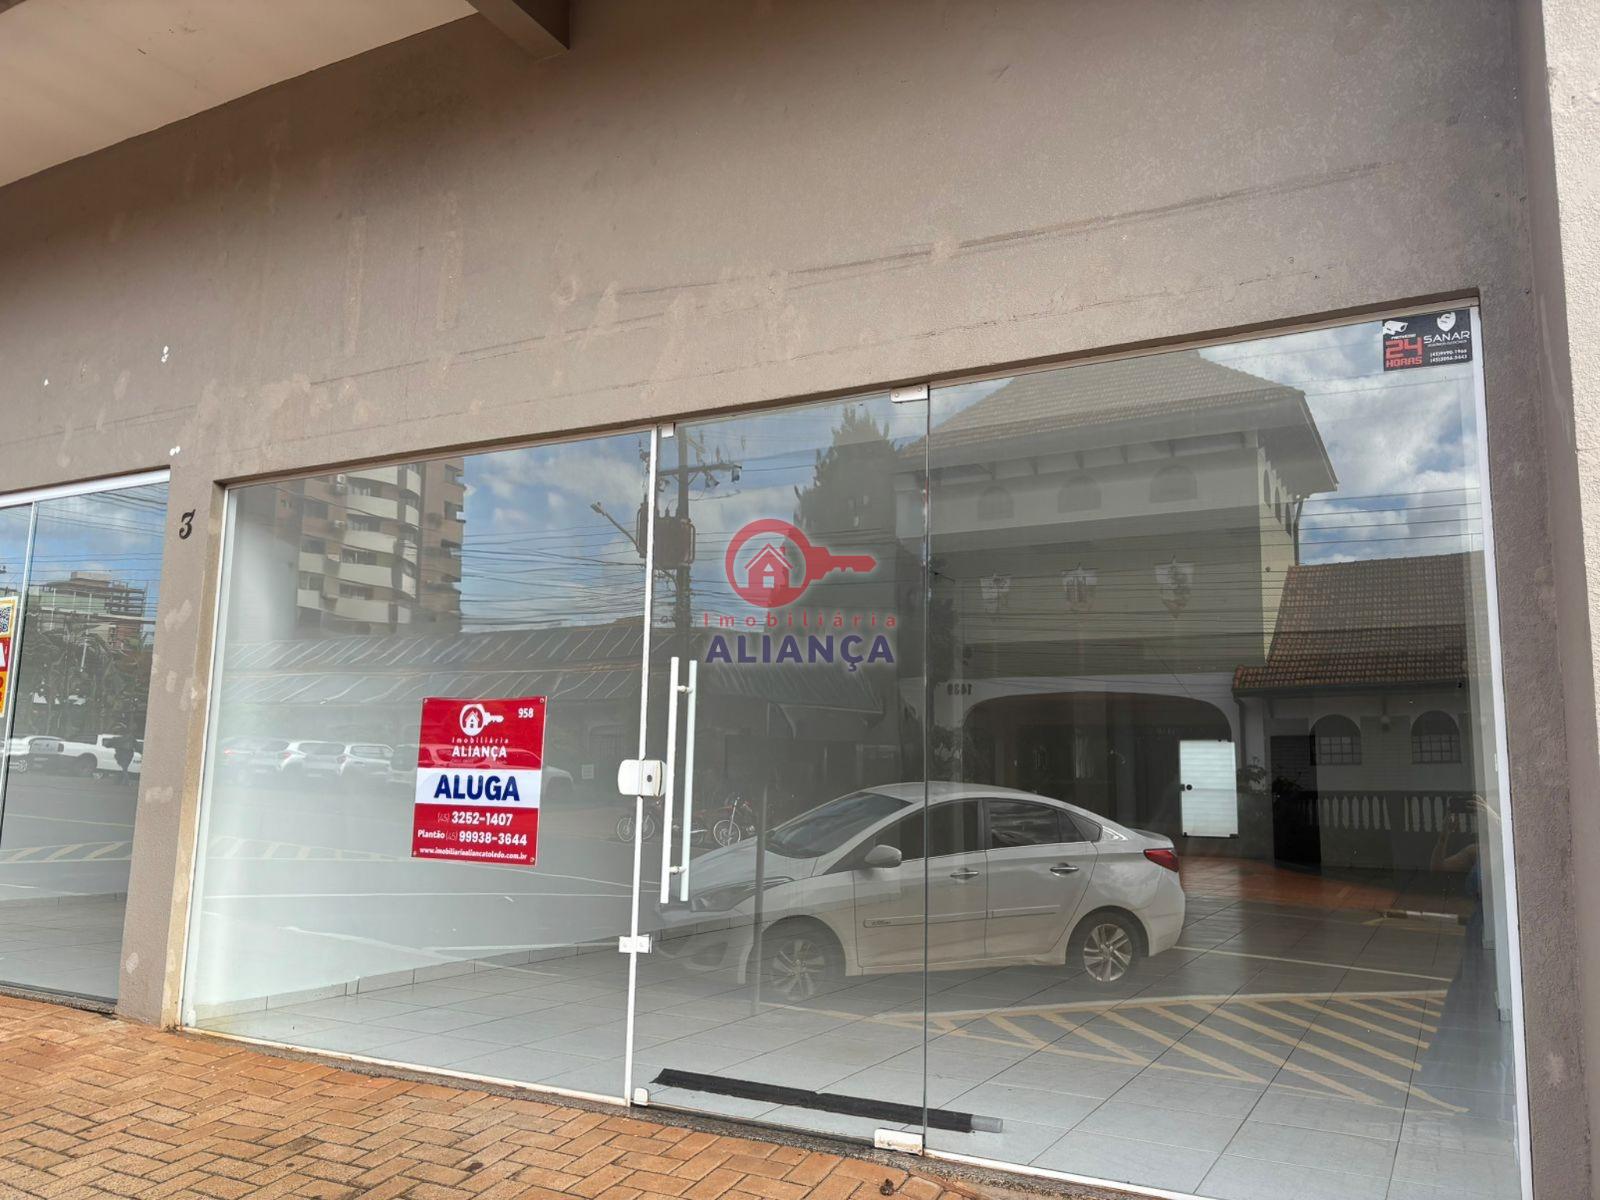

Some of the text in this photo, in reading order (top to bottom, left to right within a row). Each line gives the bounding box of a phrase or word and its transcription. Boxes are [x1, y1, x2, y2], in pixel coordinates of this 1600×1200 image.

[1423, 330, 1470, 344] SANAR
[1386, 337, 1423, 359] 24
[1386, 357, 1422, 368] HORAS
[179, 509, 196, 539] 3
[518, 708, 534, 718] 958
[452, 746, 507, 761] ALIANÇA
[434, 774, 520, 801] ALUGA
[451, 811, 513, 826] 3252-1407
[417, 829, 446, 839] Plantão
[459, 831, 528, 845] 99938-3644
